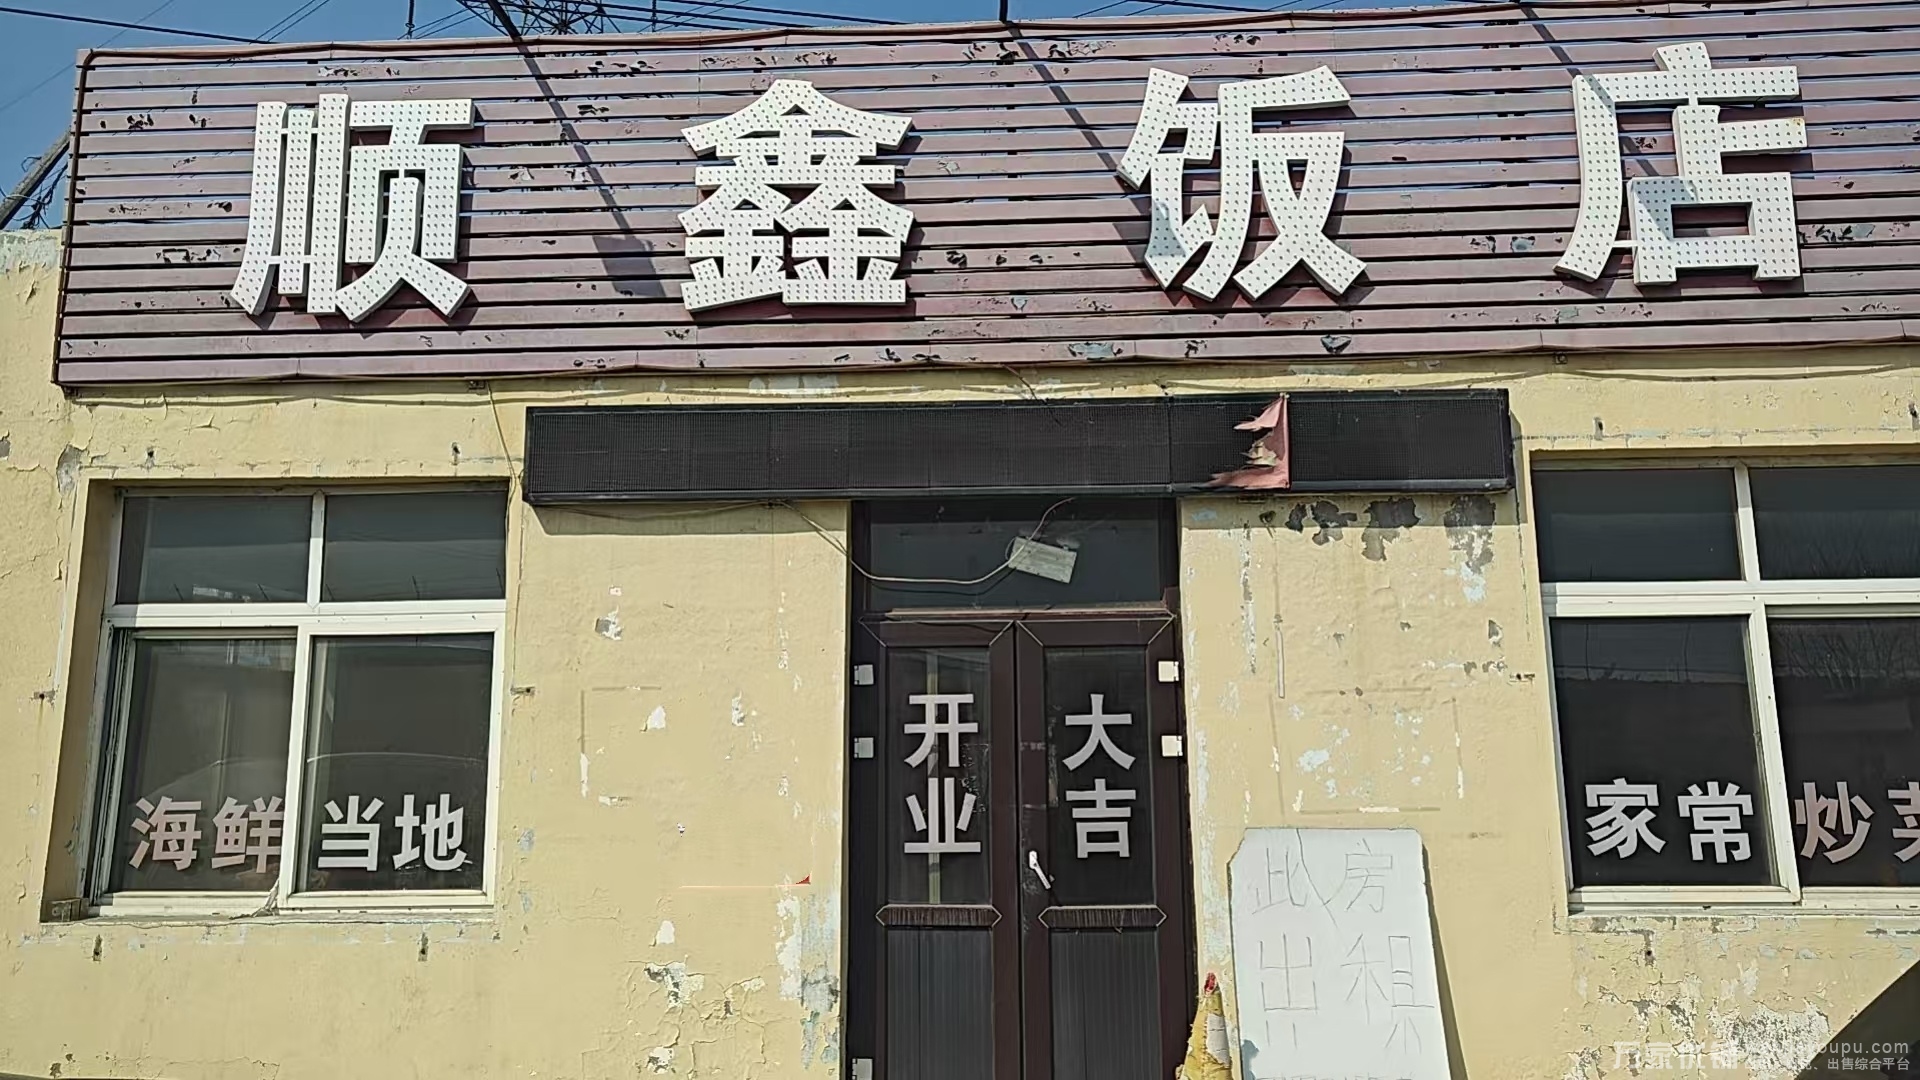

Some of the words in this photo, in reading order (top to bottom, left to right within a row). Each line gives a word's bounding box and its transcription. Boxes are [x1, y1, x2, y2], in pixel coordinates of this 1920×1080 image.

[230, 42, 1807, 322] 顺鑫饭店
[904, 693, 981, 853] 开业
[1062, 693, 1136, 858] 大吉
